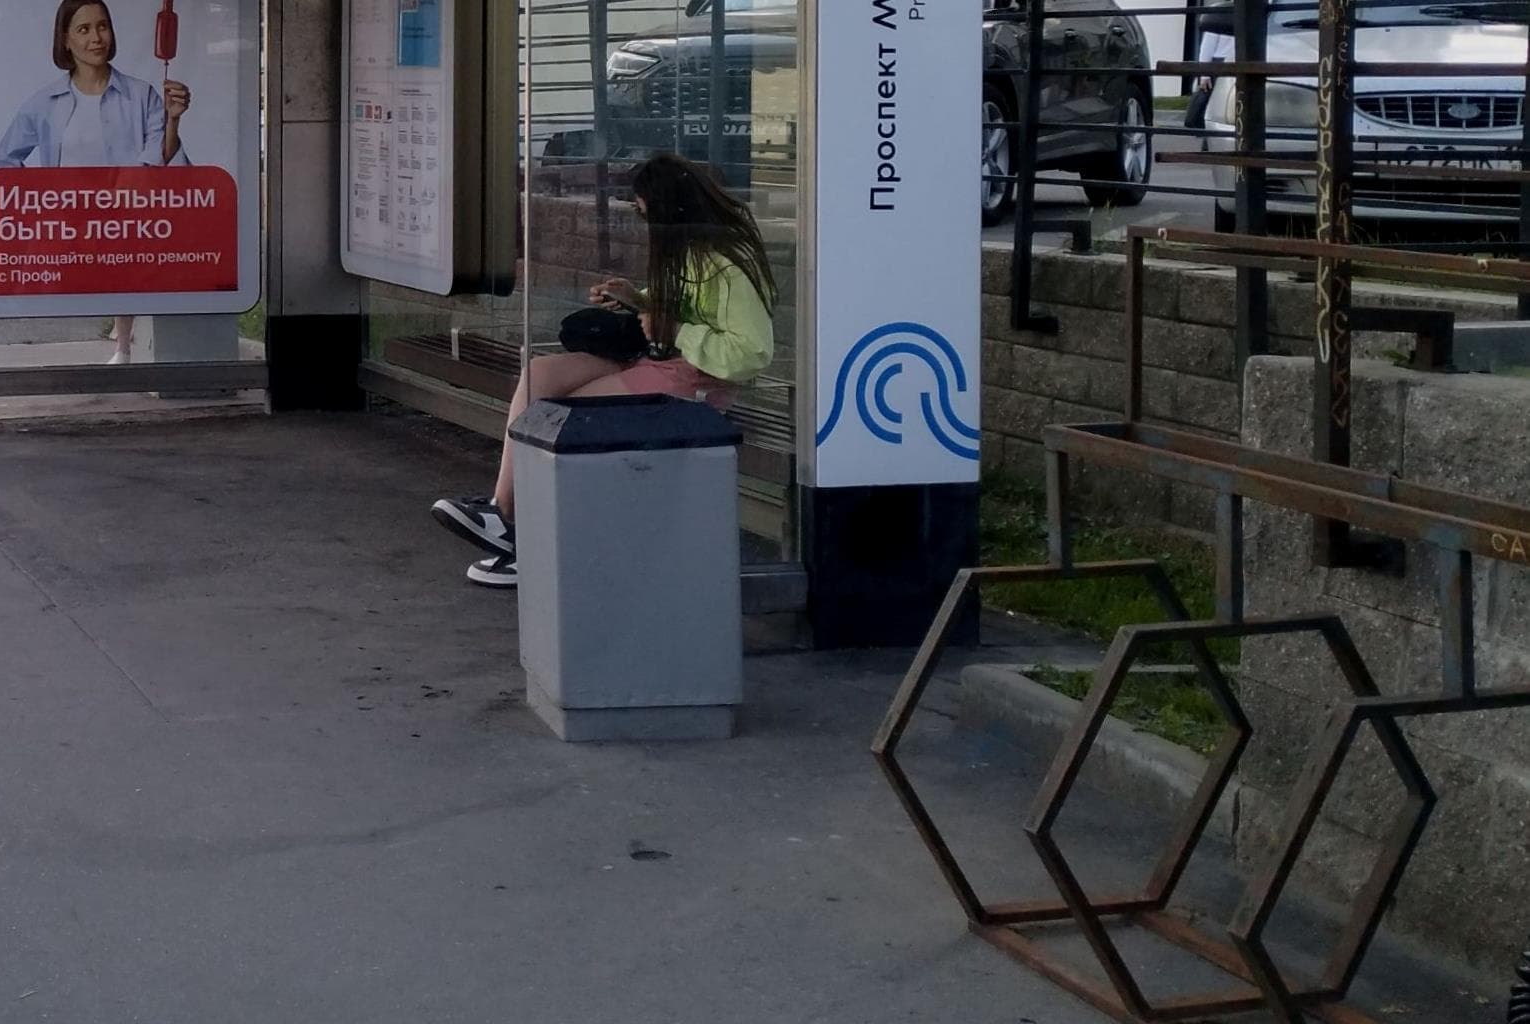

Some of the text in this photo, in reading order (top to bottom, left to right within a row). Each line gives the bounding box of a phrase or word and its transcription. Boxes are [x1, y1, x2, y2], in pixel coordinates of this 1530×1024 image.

[870, 43, 902, 210] Проспект
[84, 218, 173, 240] легко
[97, 252, 133, 264] идеи
[136, 252, 155, 264] по
[158, 251, 221, 265] ремонту
[11, 270, 61, 284] Профи
